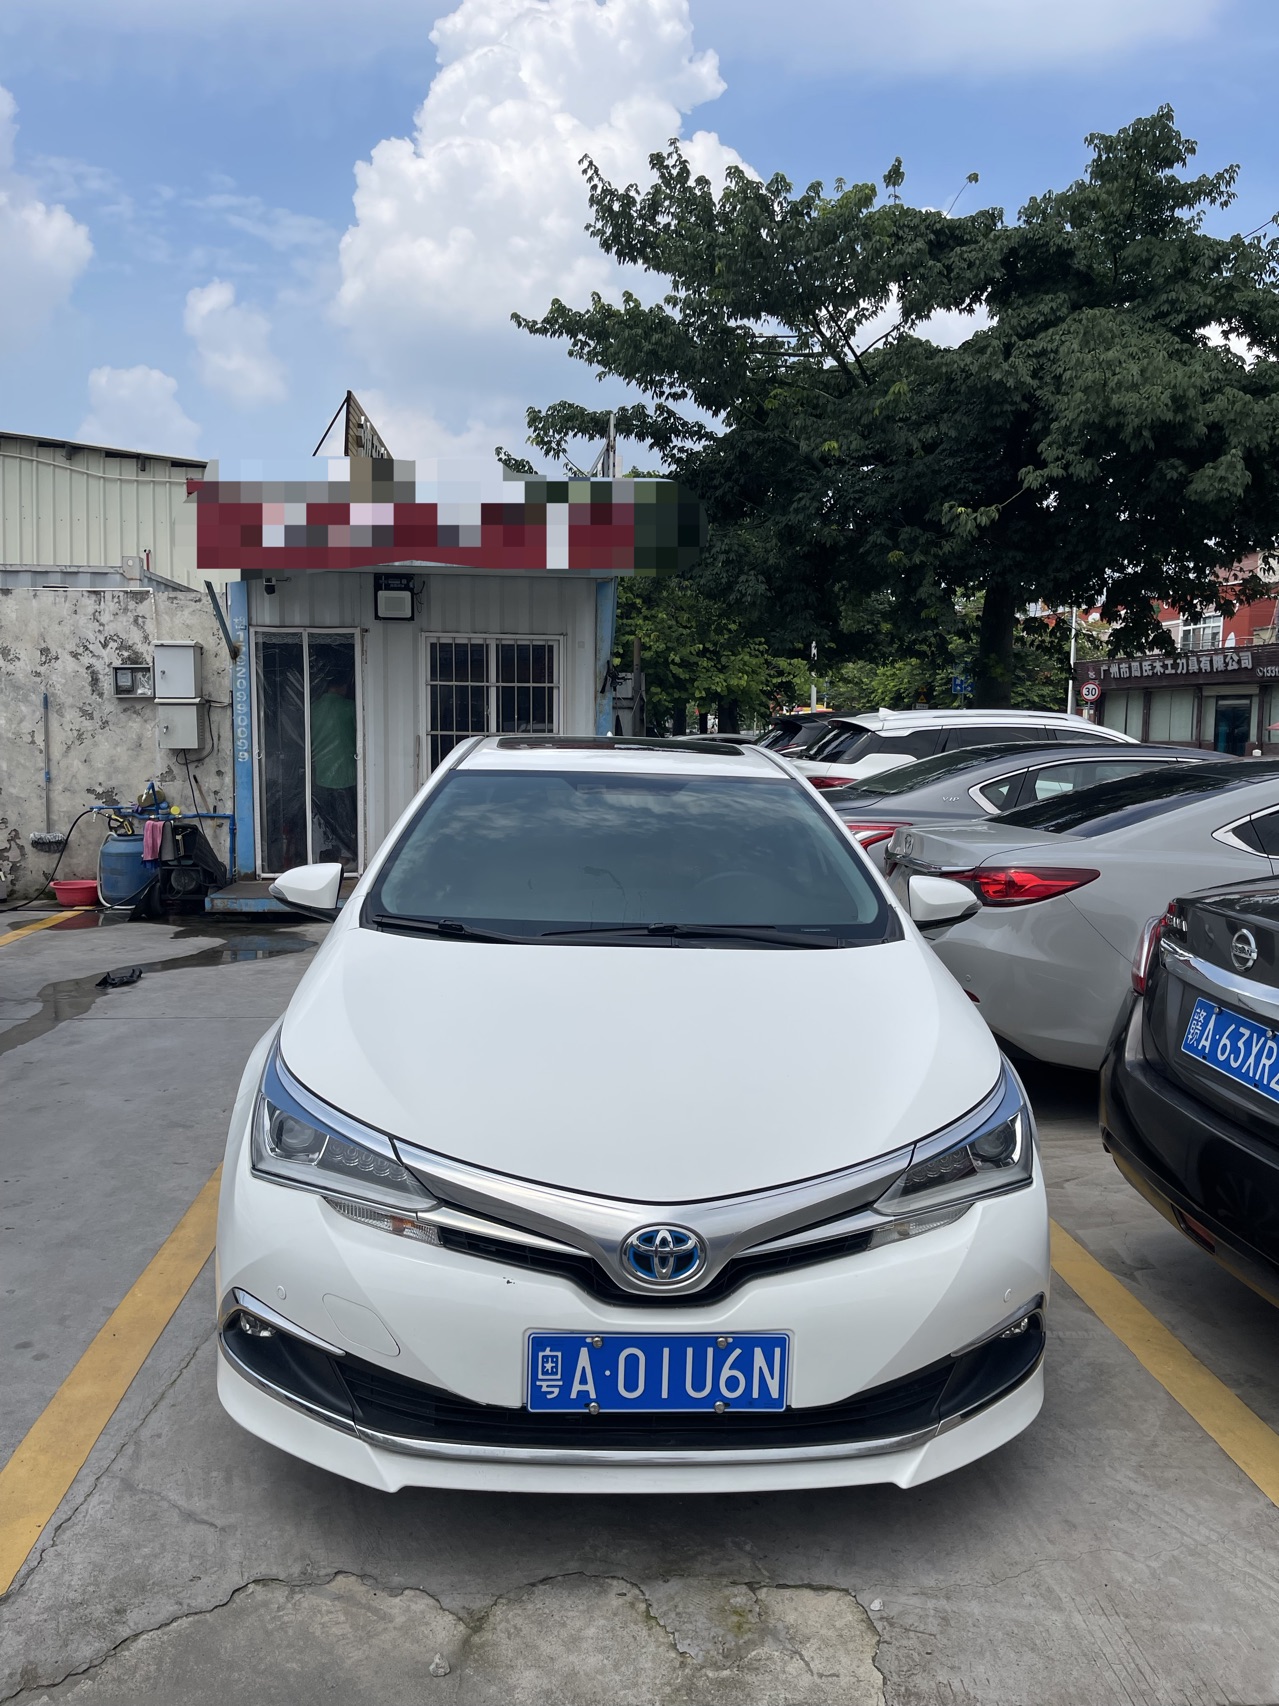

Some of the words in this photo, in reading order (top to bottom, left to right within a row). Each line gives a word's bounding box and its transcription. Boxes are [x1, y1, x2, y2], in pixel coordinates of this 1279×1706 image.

[1264, 666, 1279, 677] 1331
[1085, 687, 1097, 697] 30
[536, 1347, 781, 1399] 粤A·01U6N
